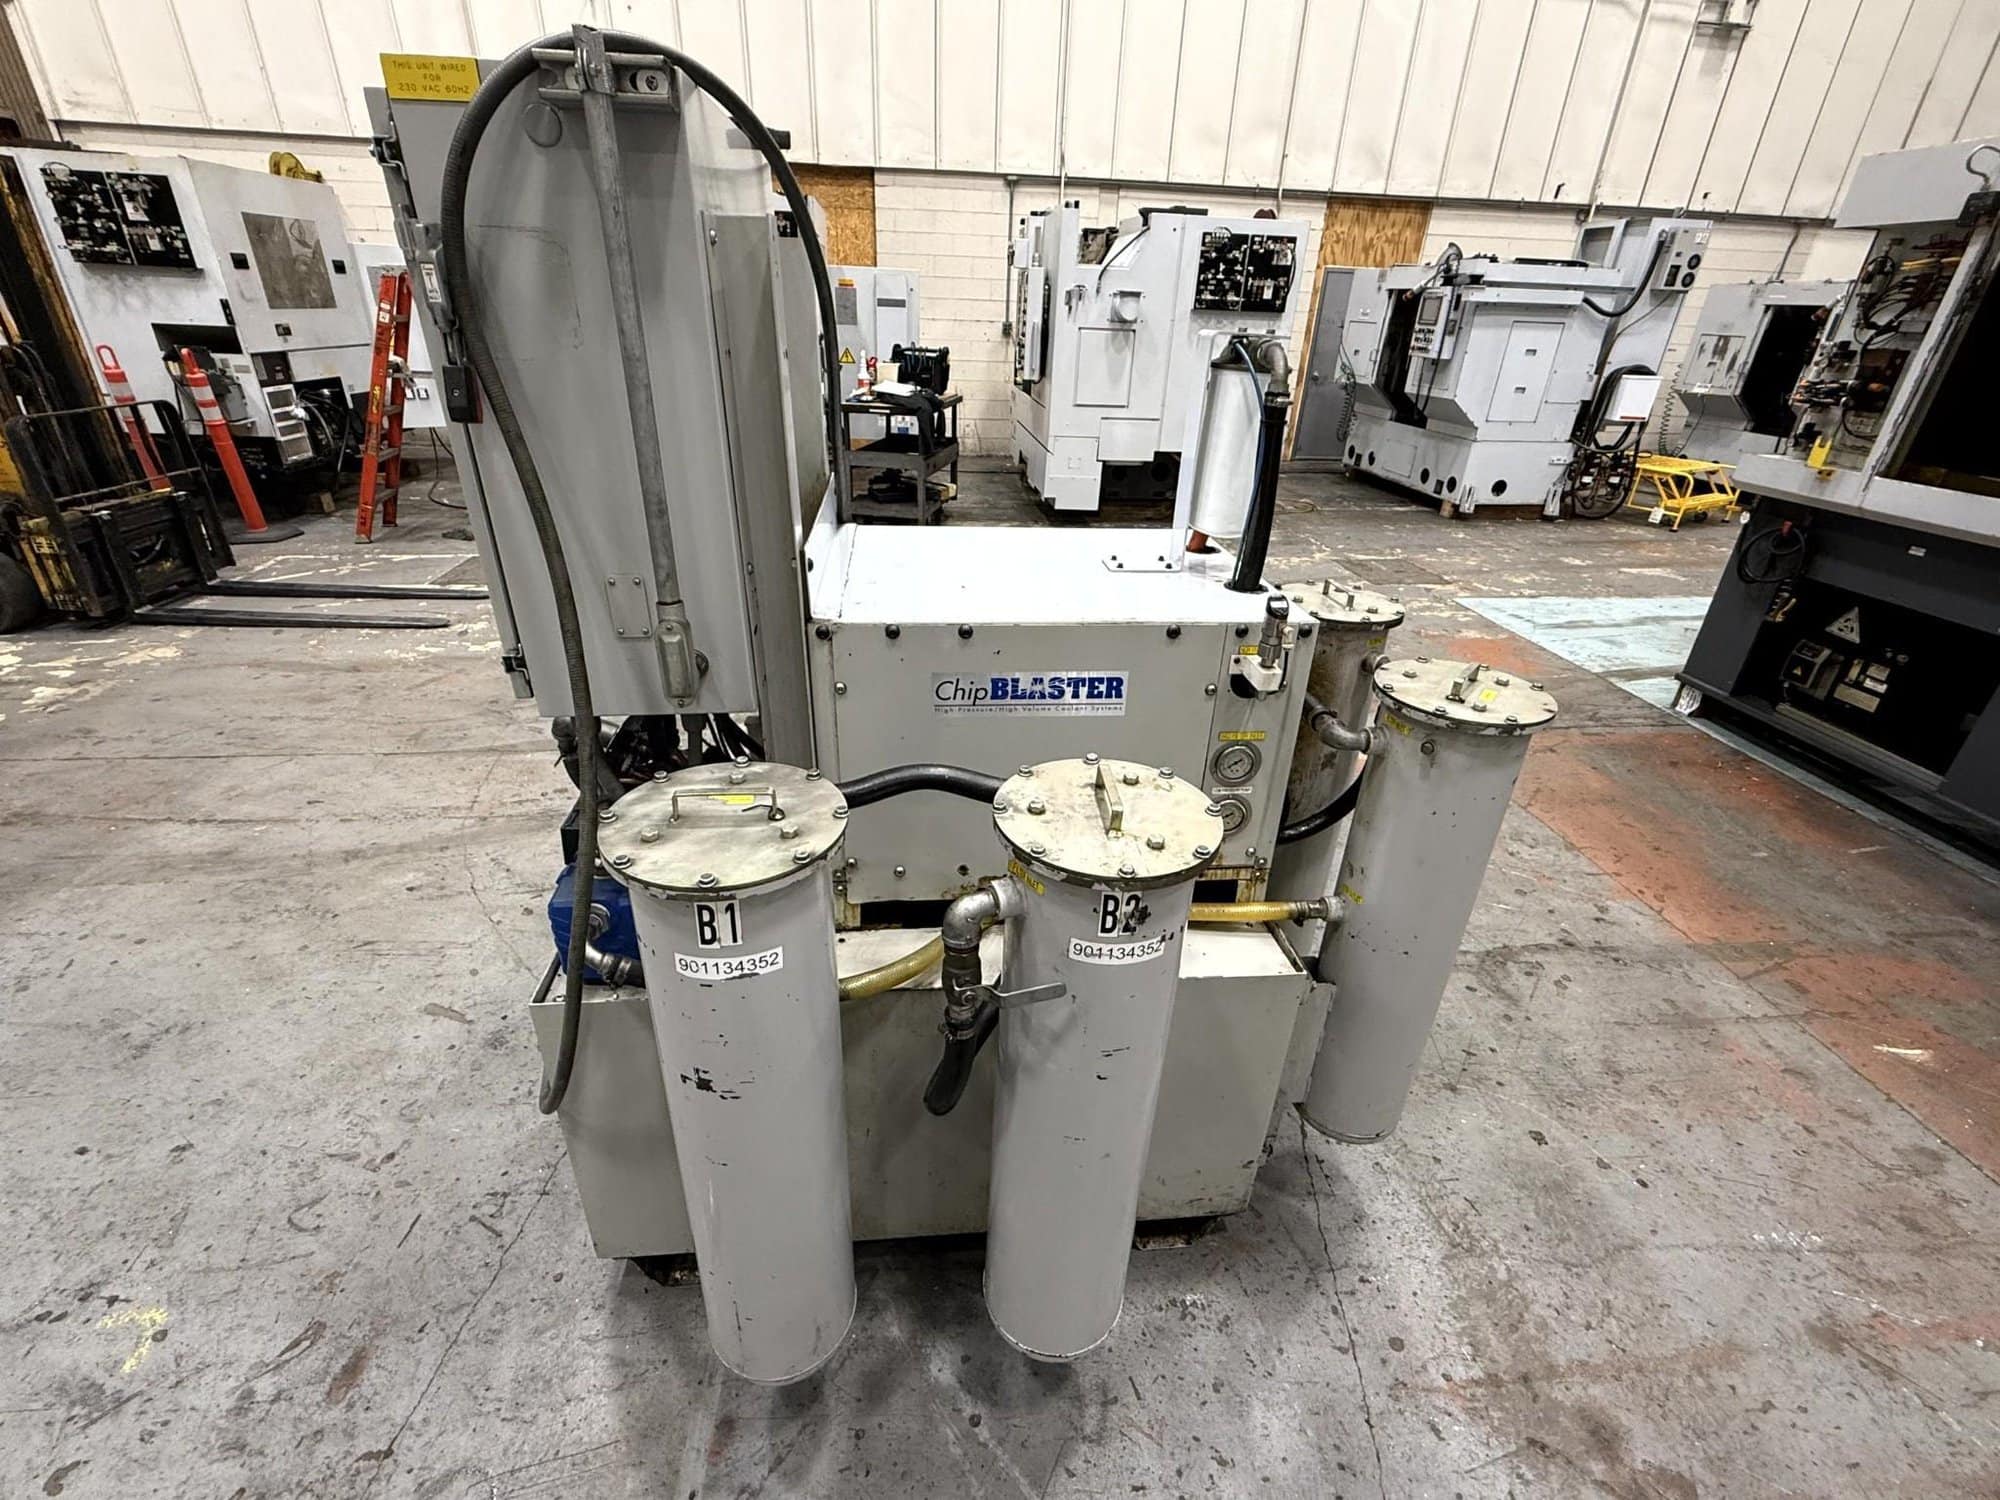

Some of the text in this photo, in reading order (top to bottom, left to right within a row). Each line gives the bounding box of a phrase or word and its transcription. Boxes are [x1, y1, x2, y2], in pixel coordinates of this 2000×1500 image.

[415, 62, 434, 70] UNIT
[440, 63, 467, 72] WIRED
[423, 73, 441, 81] FOR
[422, 84, 440, 93] VAC
[934, 706, 955, 714] High
[1091, 704, 1123, 712] Systems
[1100, 894, 1142, 934] B2
[696, 902, 738, 946] B1
[678, 952, 779, 975] 901134352
